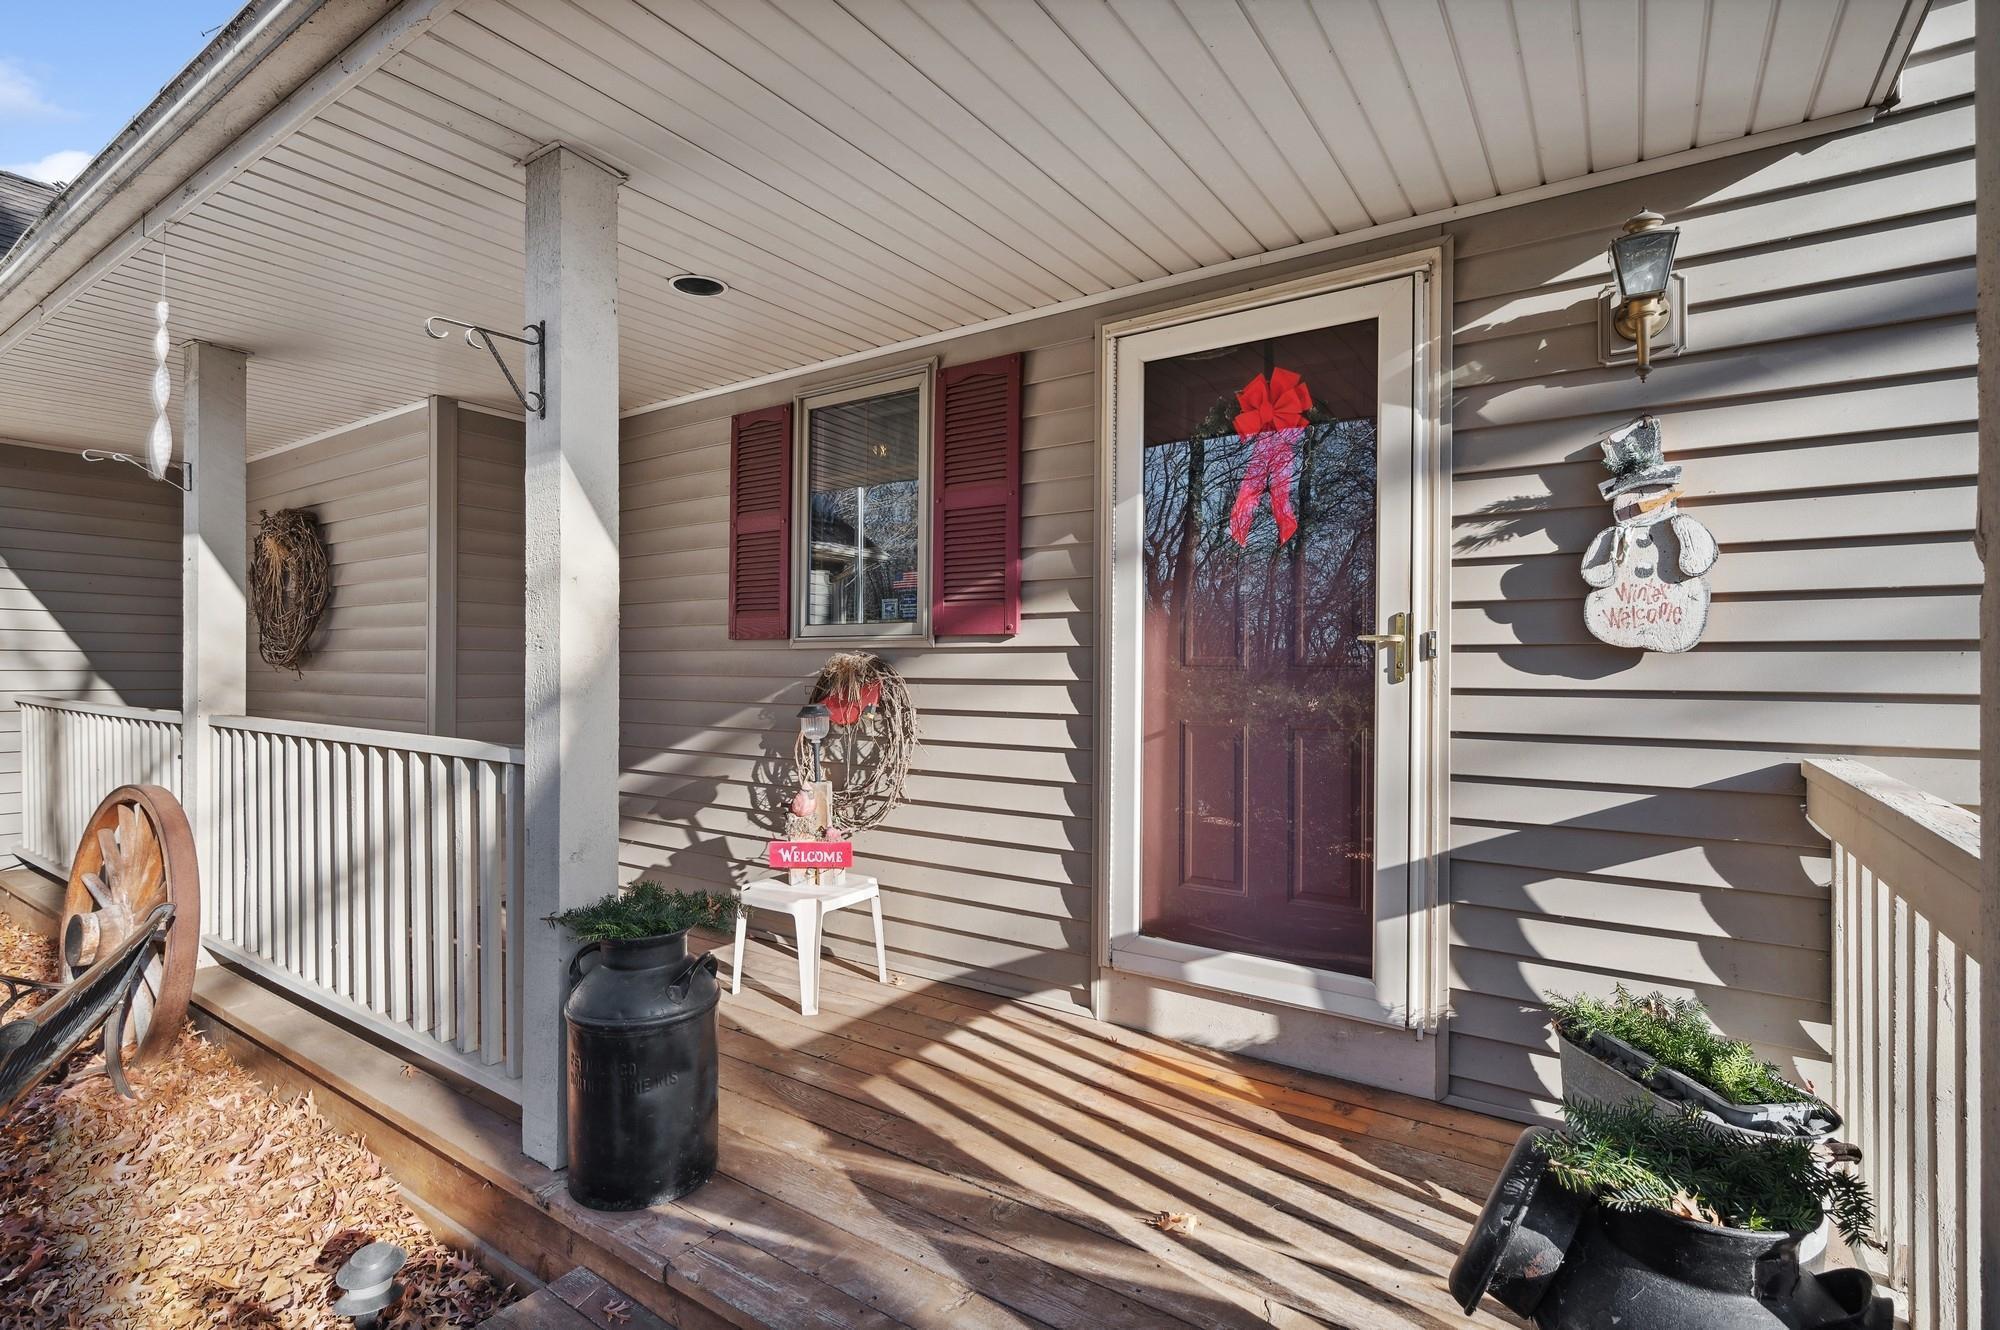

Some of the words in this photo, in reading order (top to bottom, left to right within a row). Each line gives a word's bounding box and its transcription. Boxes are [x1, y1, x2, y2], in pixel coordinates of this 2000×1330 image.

[1616, 579, 1671, 604] Winter
[1602, 602, 1682, 629] Welcome
[778, 846, 843, 863] WELCOME
